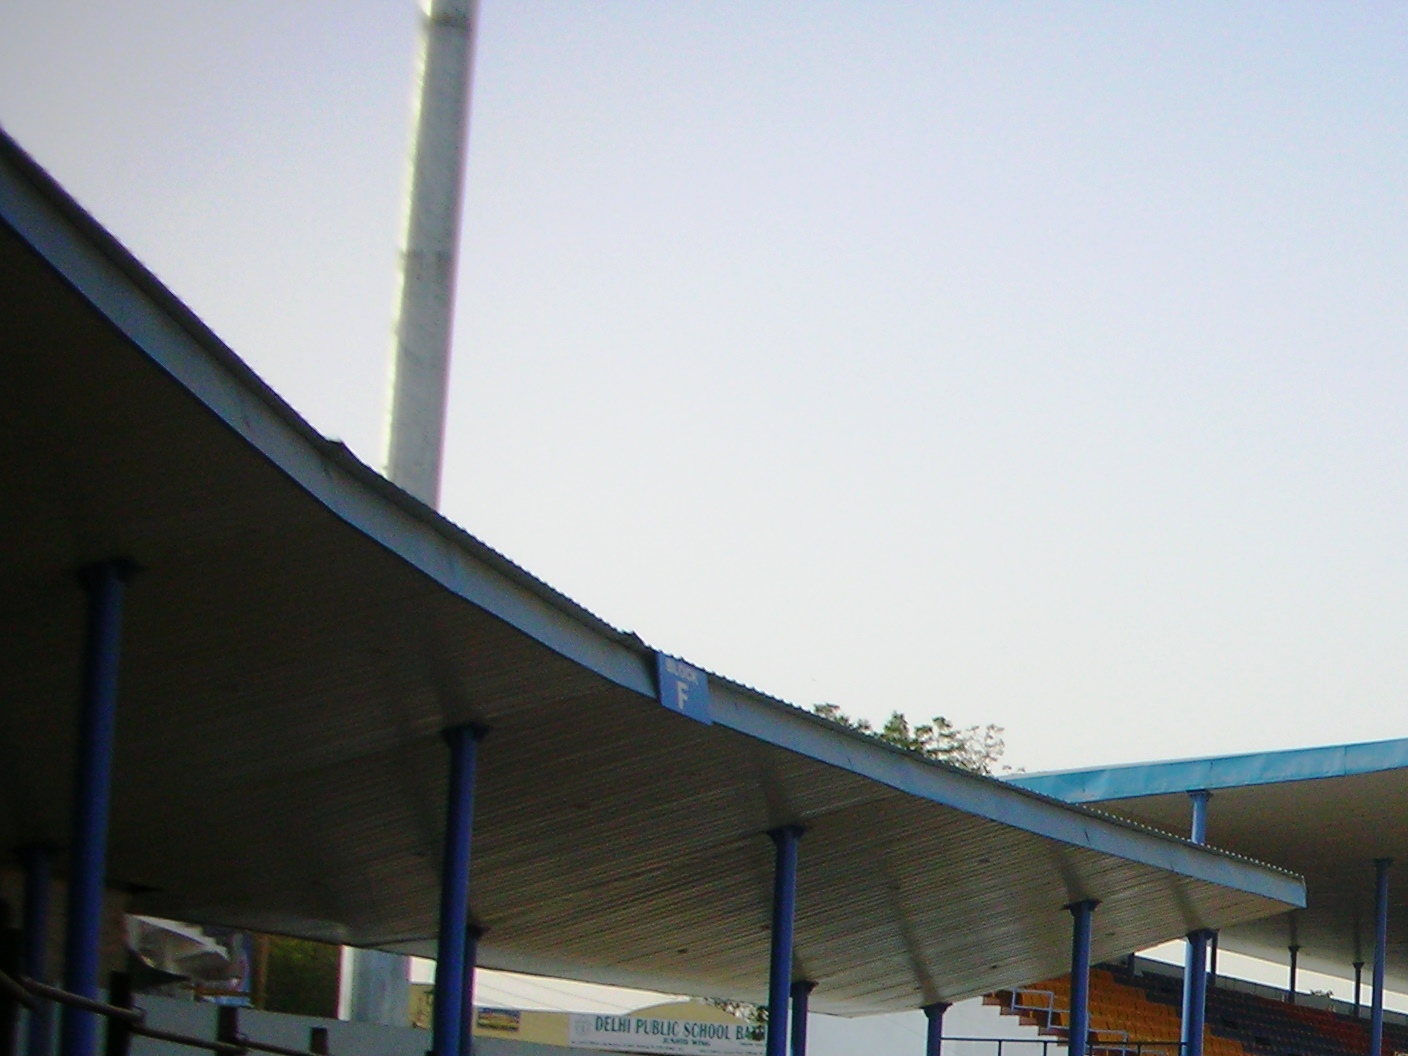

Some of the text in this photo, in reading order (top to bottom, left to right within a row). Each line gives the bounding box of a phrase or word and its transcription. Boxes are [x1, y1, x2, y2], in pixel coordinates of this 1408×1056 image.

[677, 680, 689, 709] F
[595, 1015, 631, 1034] DELHI
[635, 1018, 679, 1037] PUBLIC
[683, 1021, 730, 1040] SCHOOL
